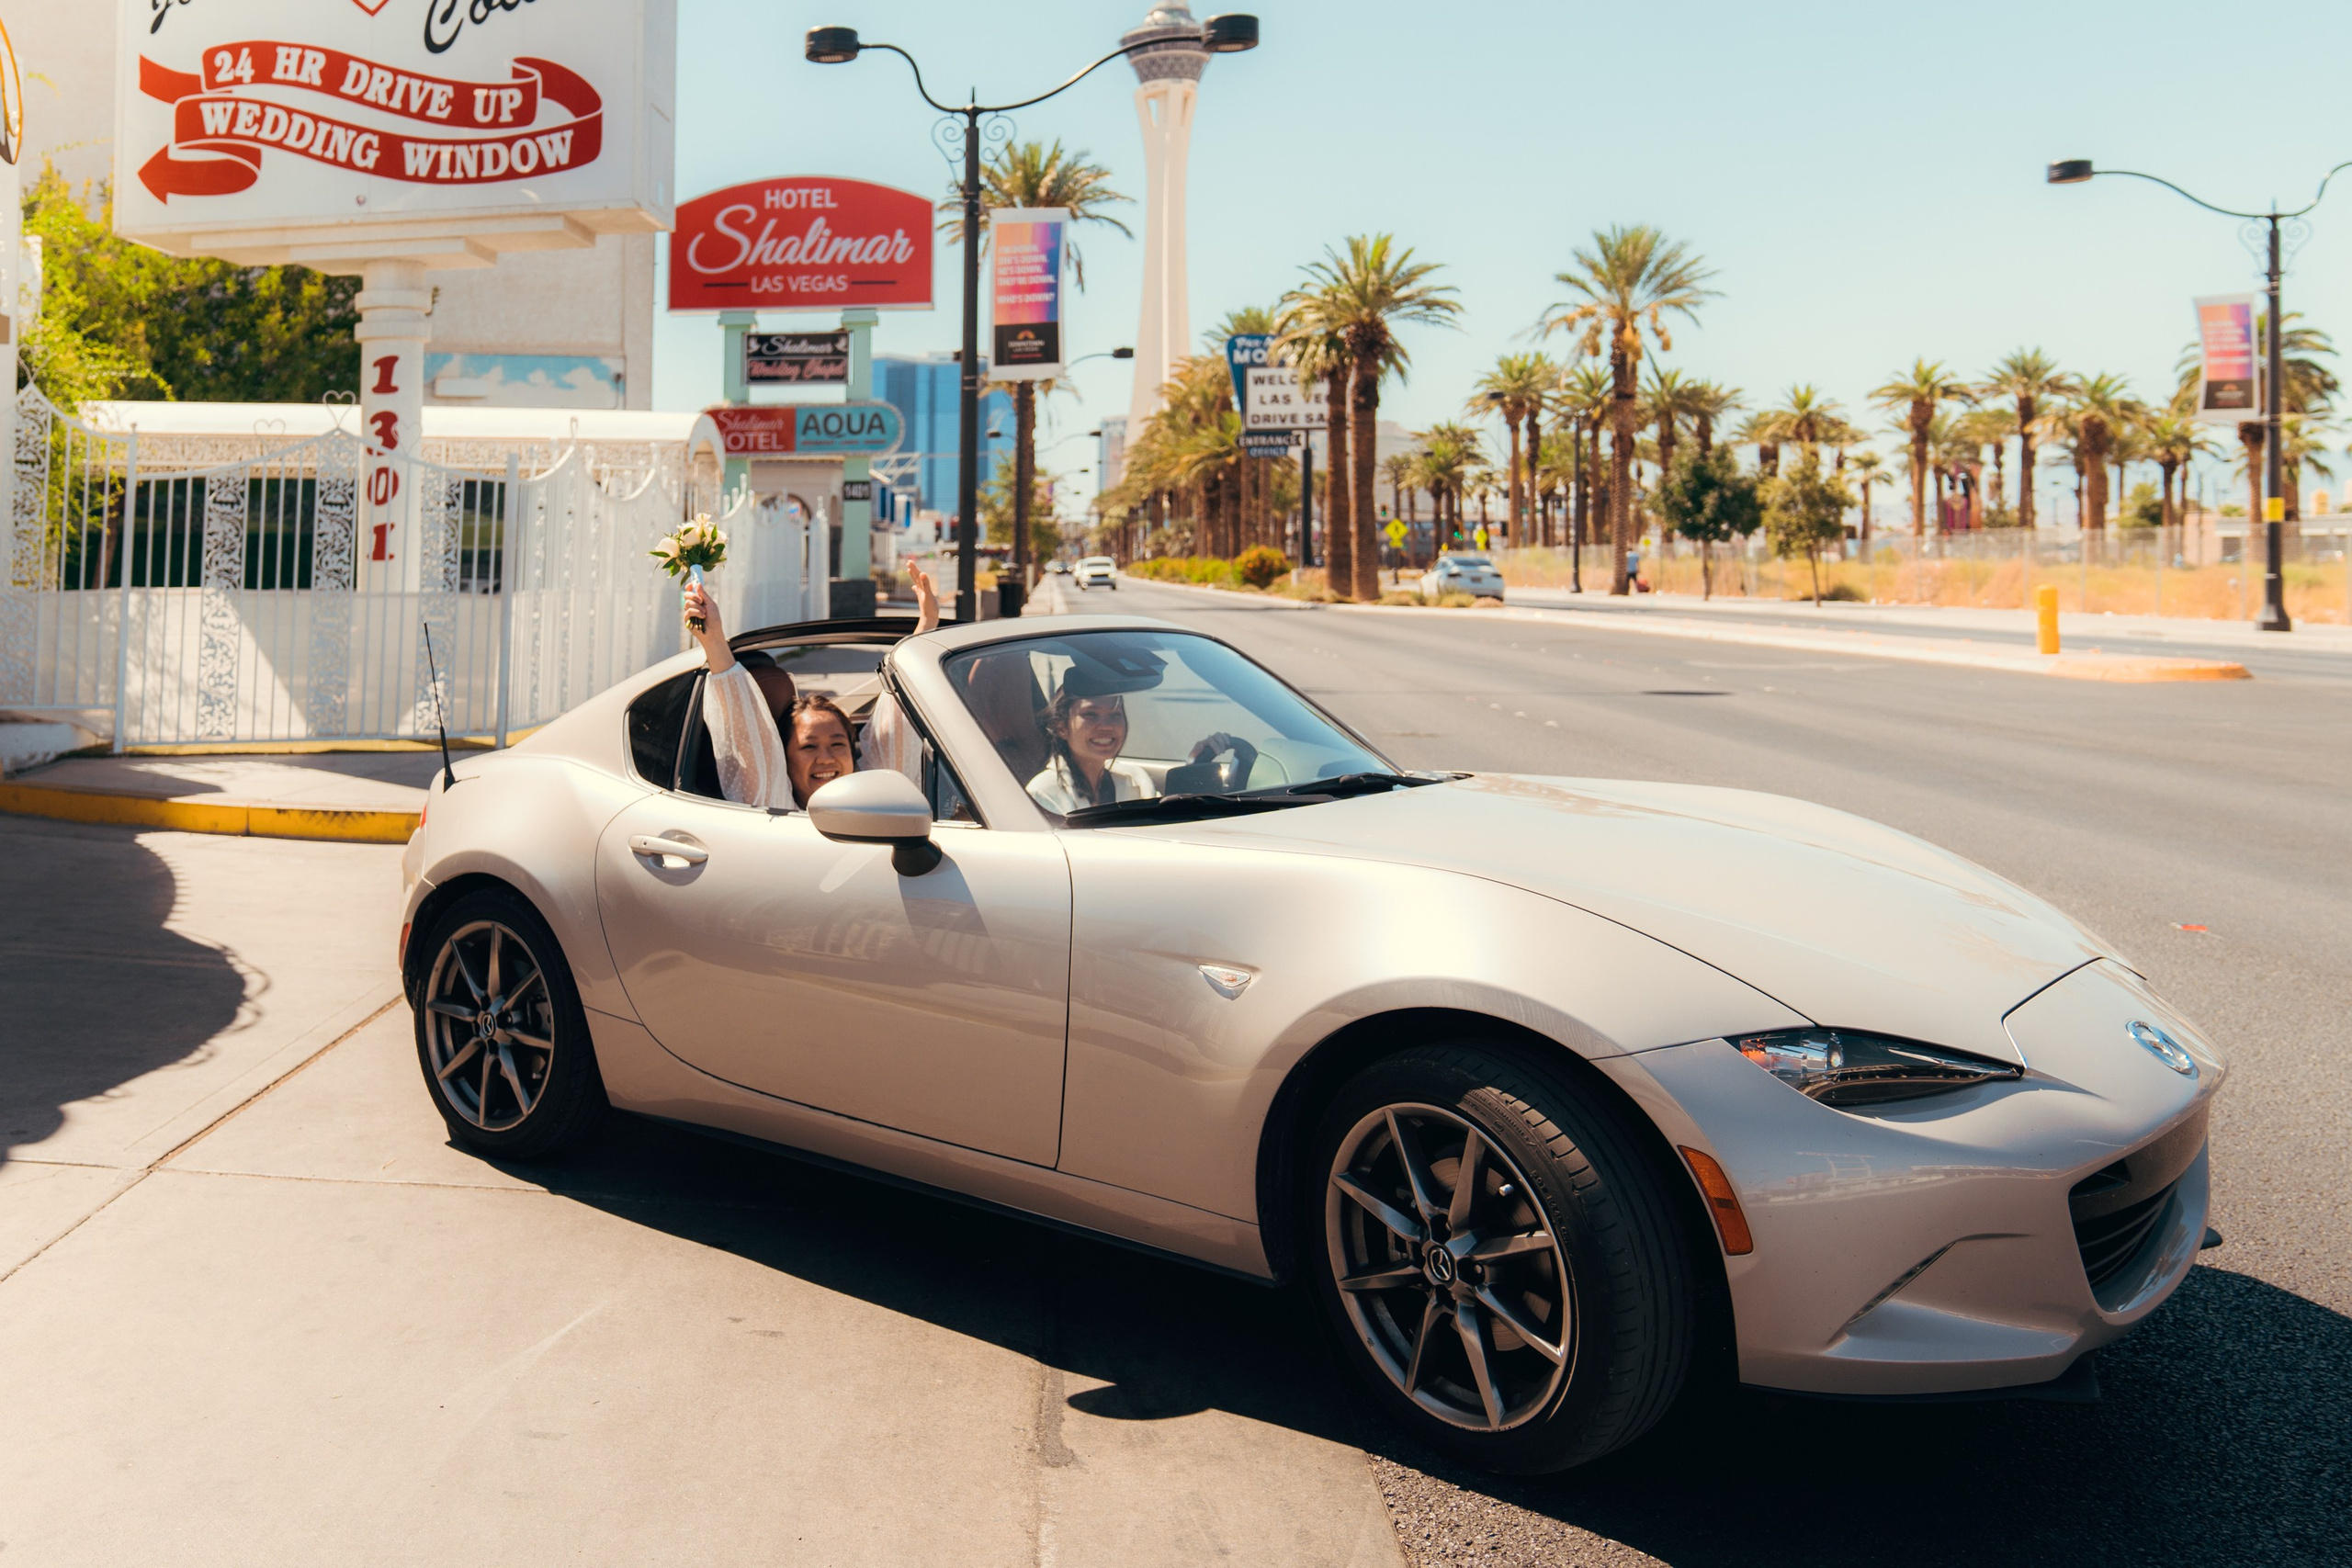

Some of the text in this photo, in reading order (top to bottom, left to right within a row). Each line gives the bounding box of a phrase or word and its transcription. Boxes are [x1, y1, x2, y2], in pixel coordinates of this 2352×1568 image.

[214, 47, 524, 123] 24 HR DRIVE UP
[199, 101, 574, 179] WEDDING WINDOW
[764, 188, 837, 209] HOTEL
[687, 204, 914, 274] Shalimar
[751, 275, 848, 293] LAS VEGAS
[761, 335, 833, 355] Shalimar
[749, 357, 845, 381] Wedding Chapel
[1260, 394, 1291, 404] LAS
[718, 409, 785, 434] Shalimar
[802, 412, 886, 438] AQUA
[1251, 413, 1298, 423] DRIVE
[1238, 434, 1297, 446] ENTRANCE
[367, 355, 400, 561] 1301
